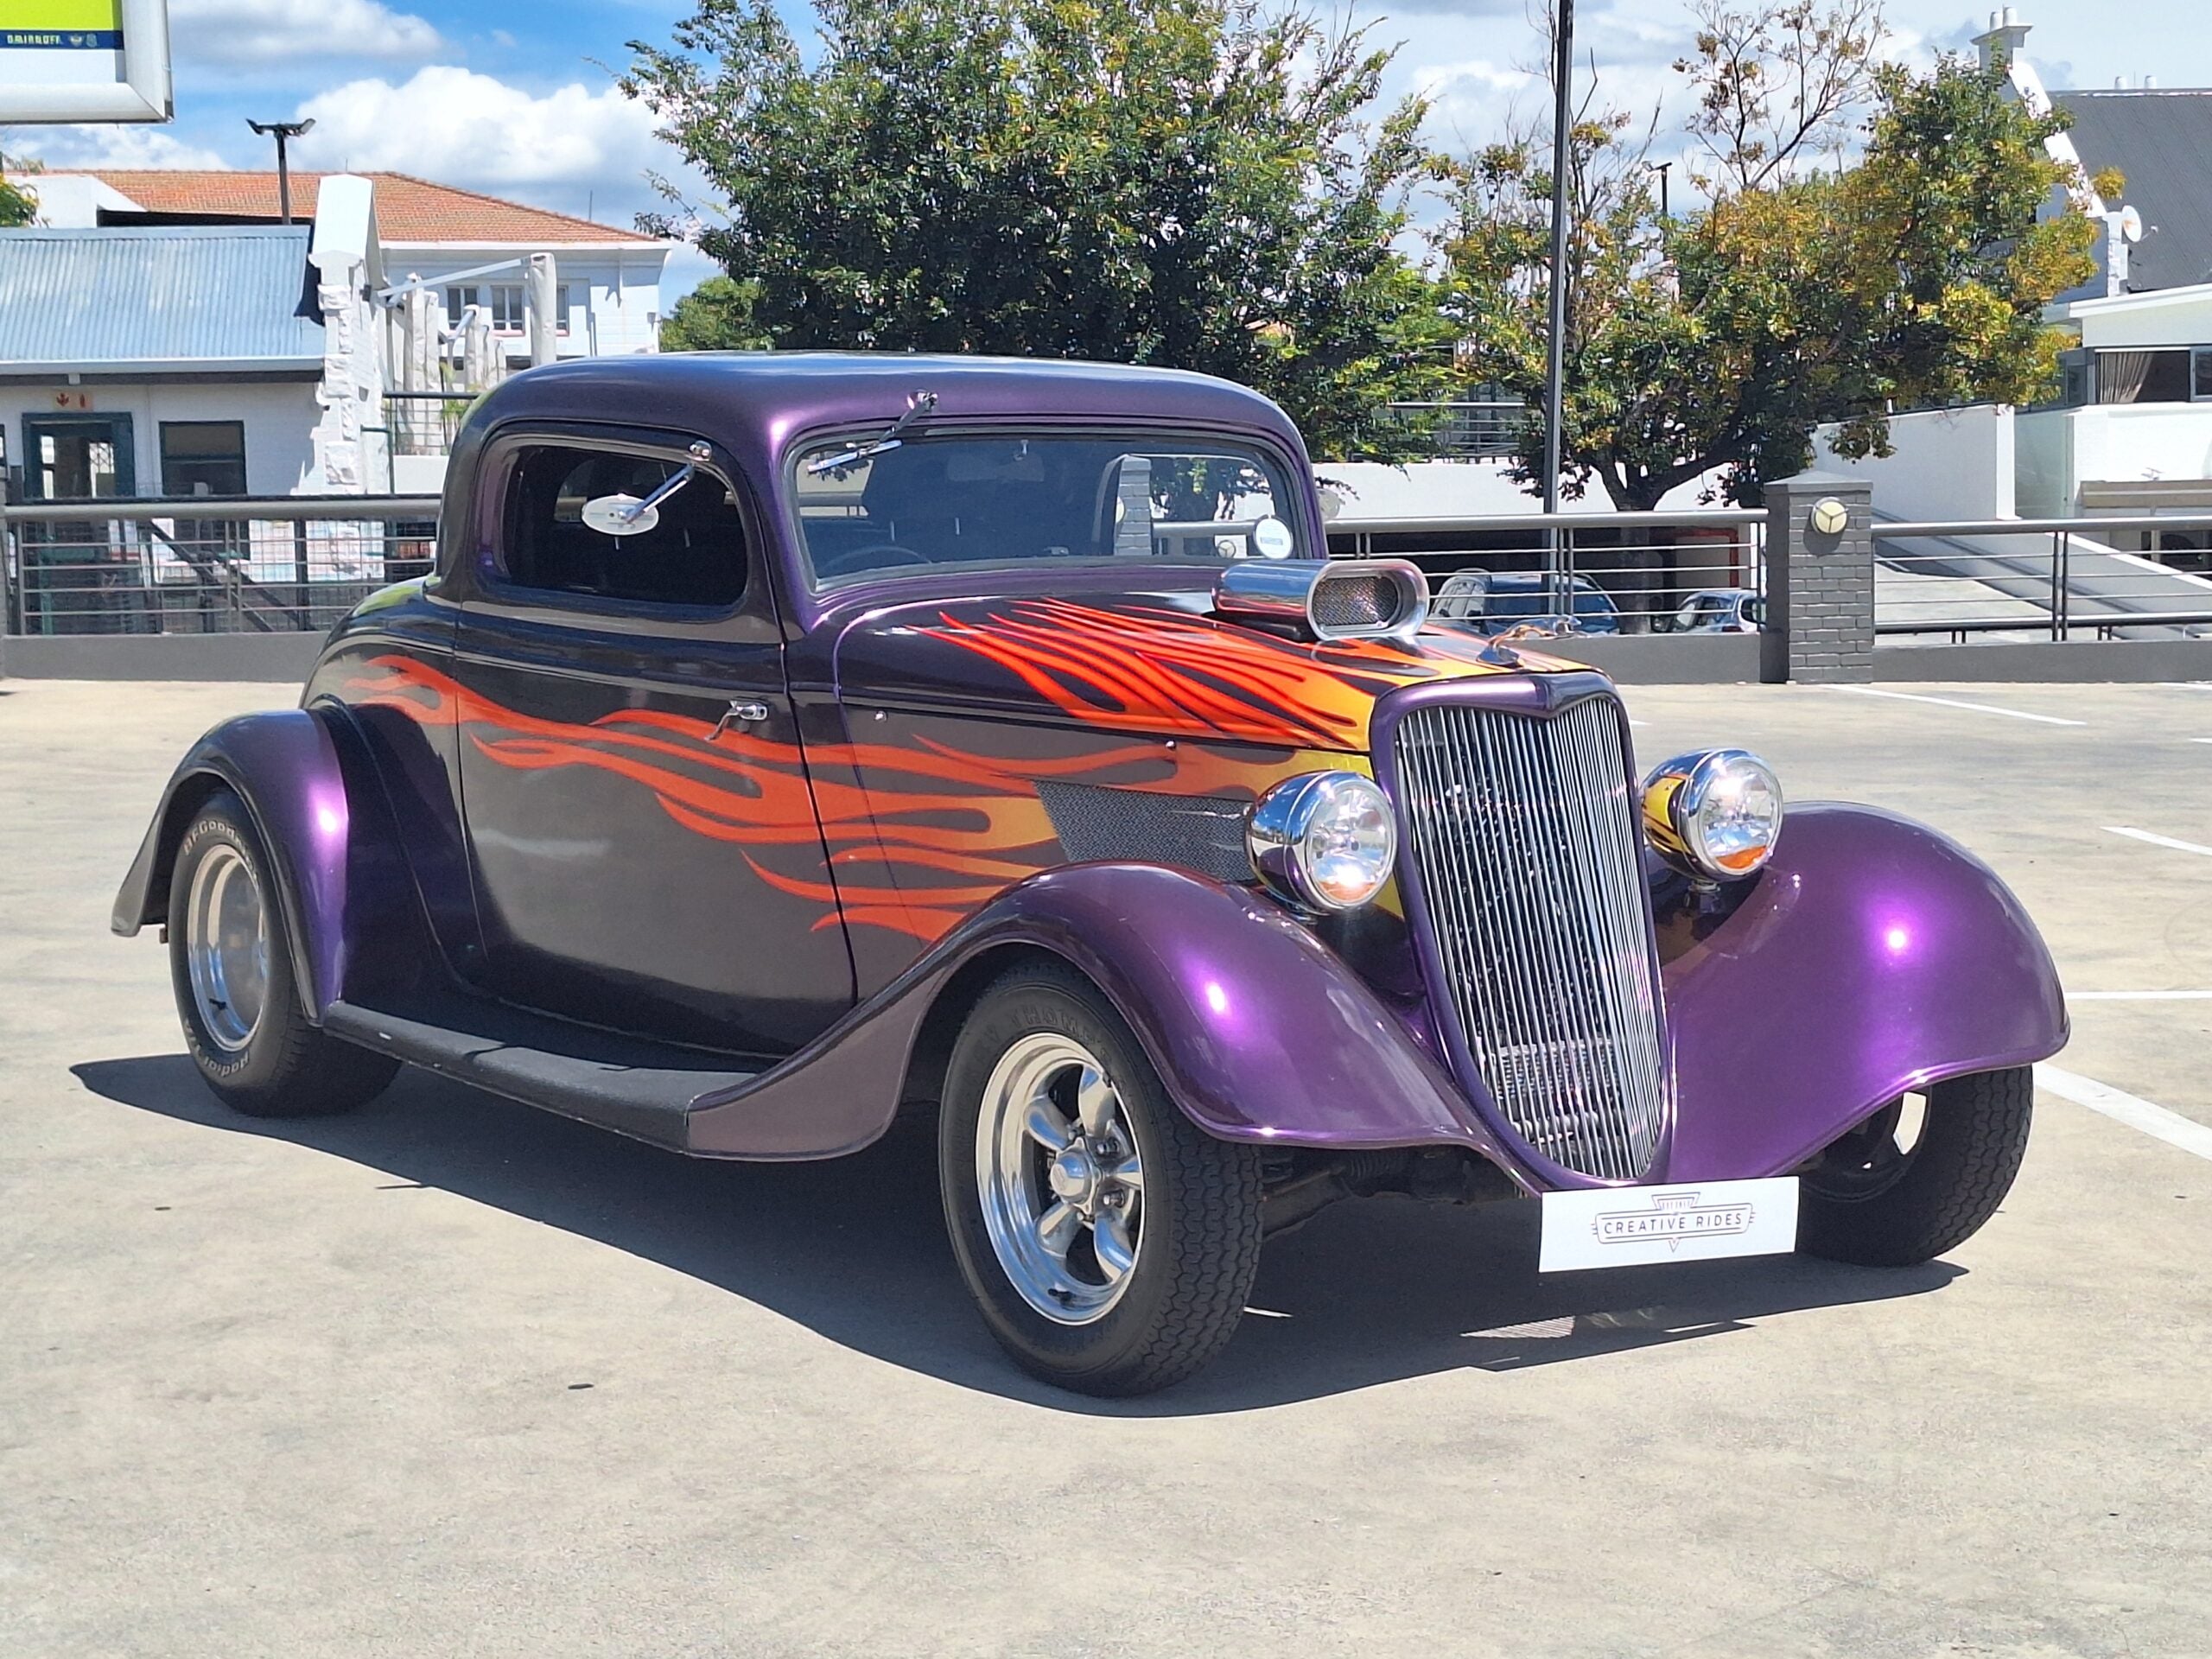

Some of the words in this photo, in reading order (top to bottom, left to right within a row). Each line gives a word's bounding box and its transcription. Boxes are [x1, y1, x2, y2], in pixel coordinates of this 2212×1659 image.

[204, 1051, 249, 1077] Radial
[1604, 1217, 1686, 1234] CREATIVE
[1696, 1213, 1742, 1227] RIDES
